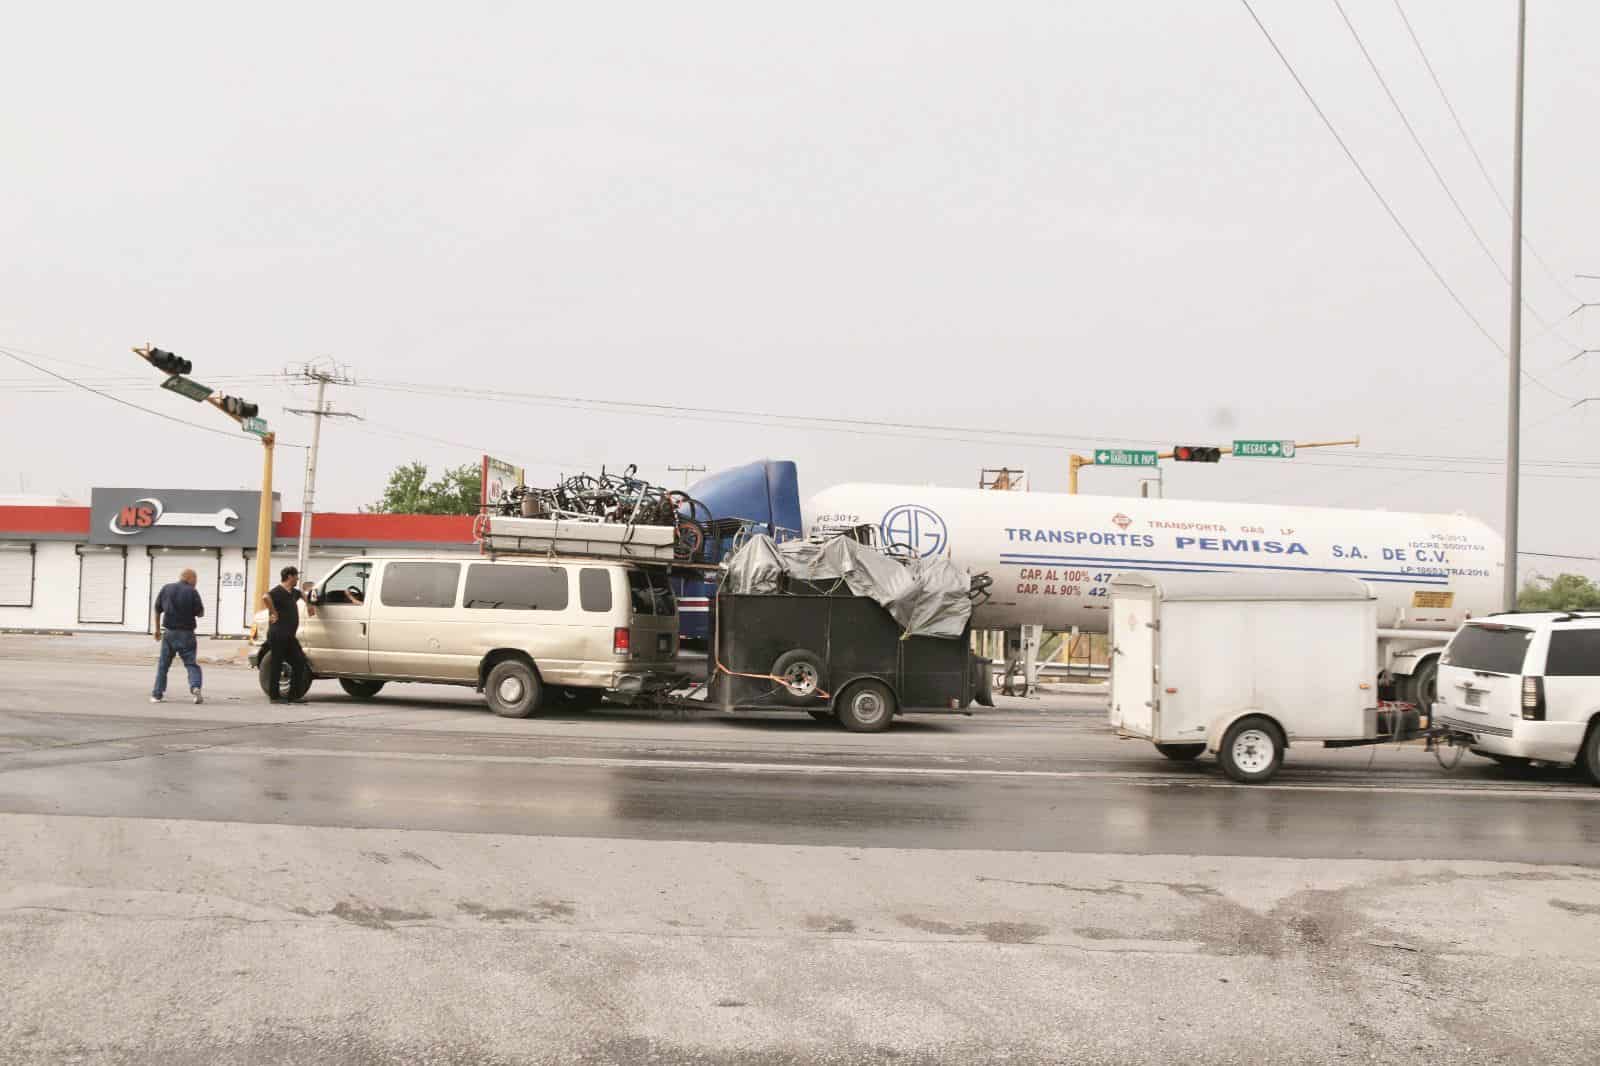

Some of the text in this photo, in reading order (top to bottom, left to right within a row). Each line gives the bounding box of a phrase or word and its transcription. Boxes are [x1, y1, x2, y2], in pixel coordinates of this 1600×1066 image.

[119, 505, 155, 528] NS
[1147, 520, 1227, 532] TRANSPORTA
[1004, 527, 1450, 564] TRANSPORTES PEMISA S.A. DE C.V.
[1020, 568, 1042, 581] CAP.
[1045, 569, 1059, 582] AL
[1063, 570, 1090, 583] 100%
[1016, 583, 1039, 595] CAP.
[1043, 584, 1058, 596] AL
[1060, 584, 1081, 596] 90%
